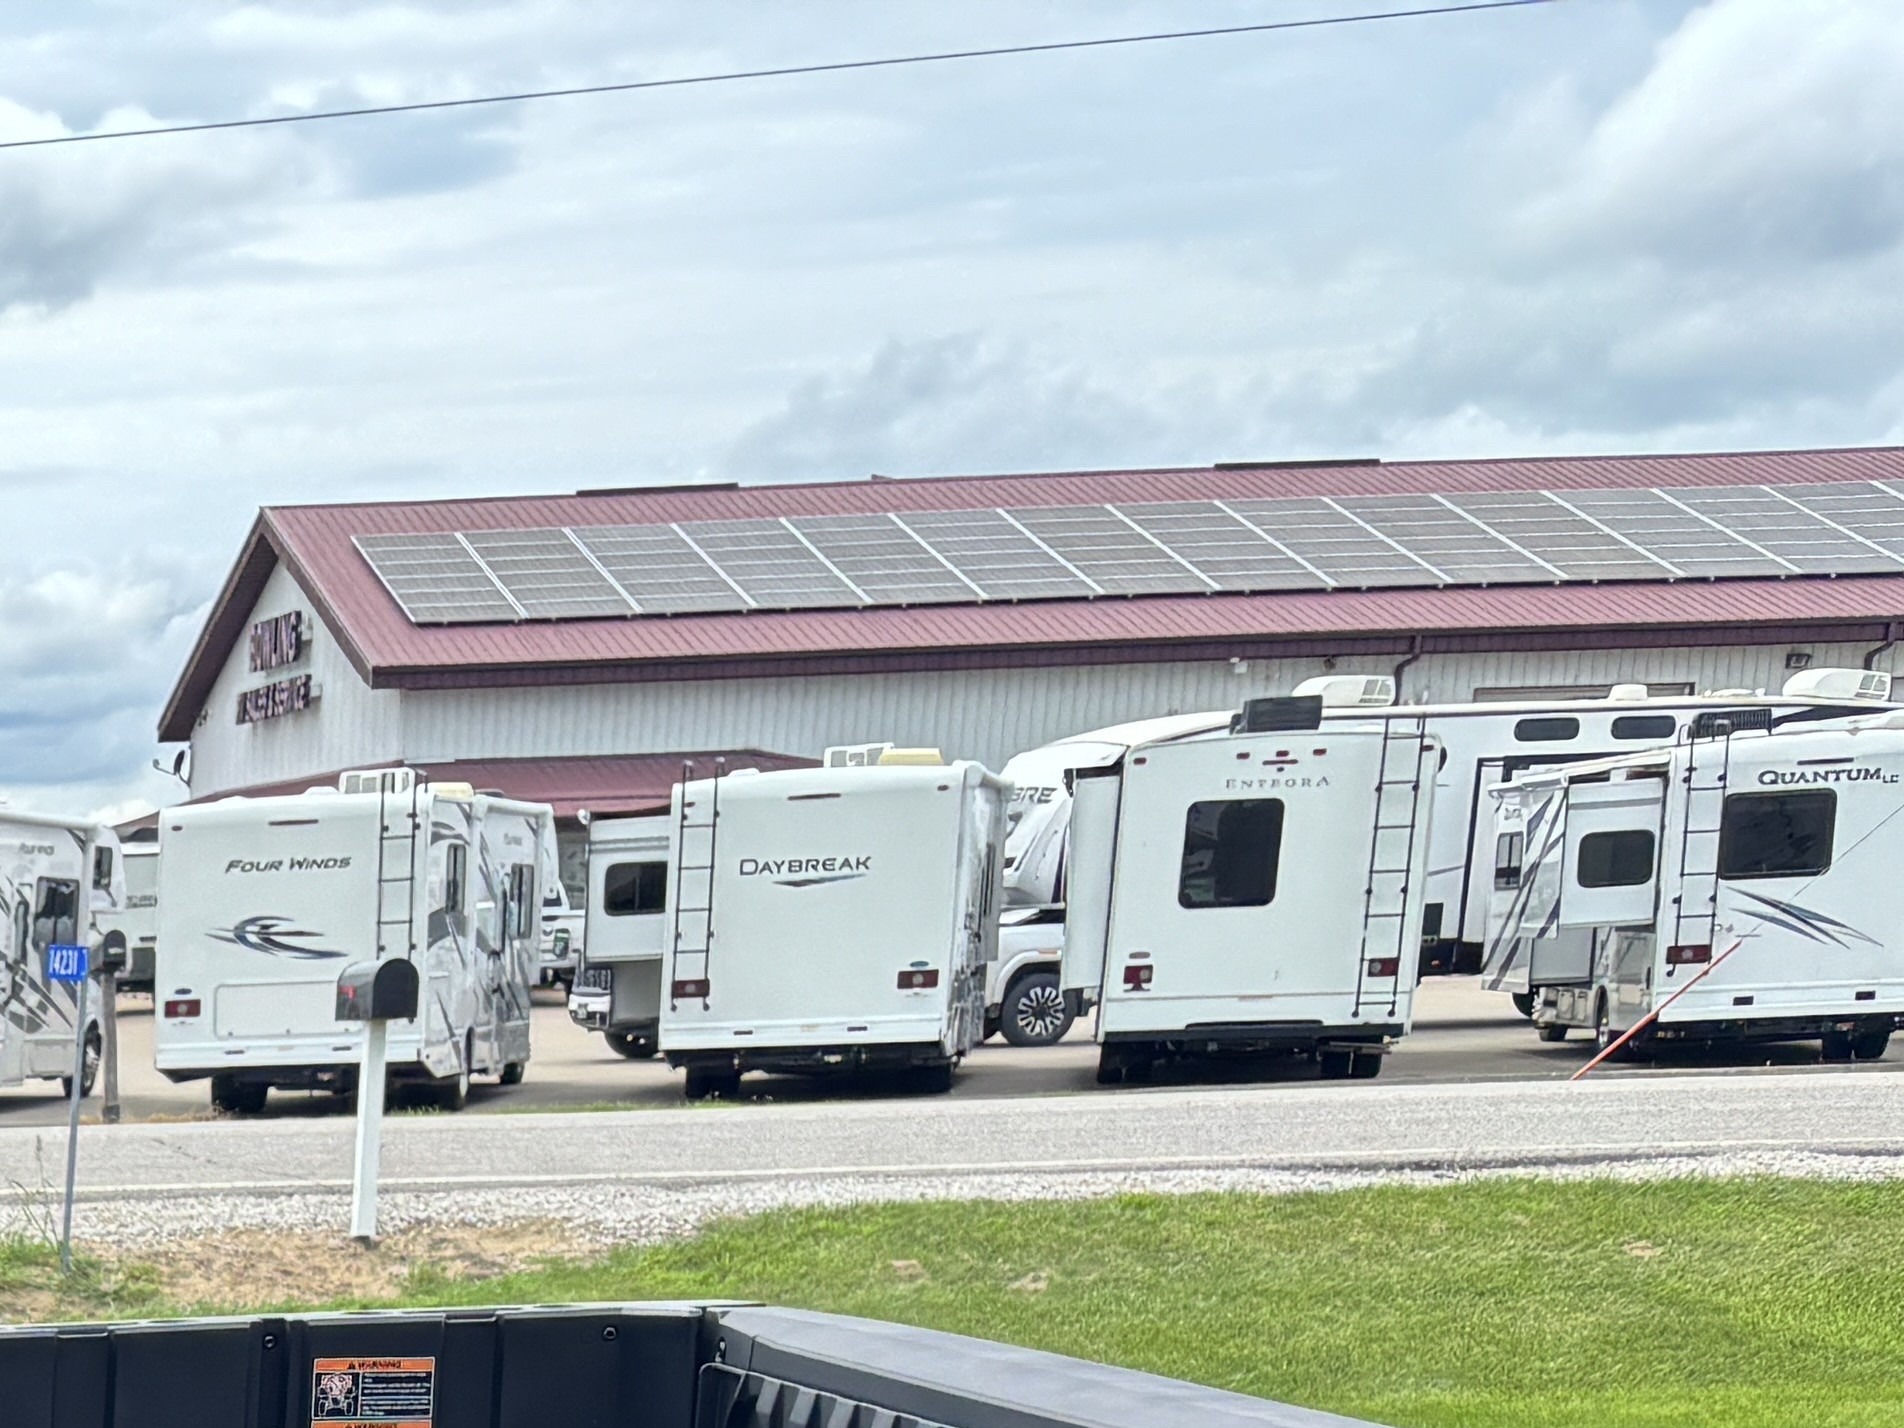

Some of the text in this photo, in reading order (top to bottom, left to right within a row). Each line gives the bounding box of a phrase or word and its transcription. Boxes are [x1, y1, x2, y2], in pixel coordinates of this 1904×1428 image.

[1757, 767, 1882, 785] QUANTUM
[224, 856, 353, 874] FOUR WINDS
[739, 855, 872, 876] DAYBREAK
